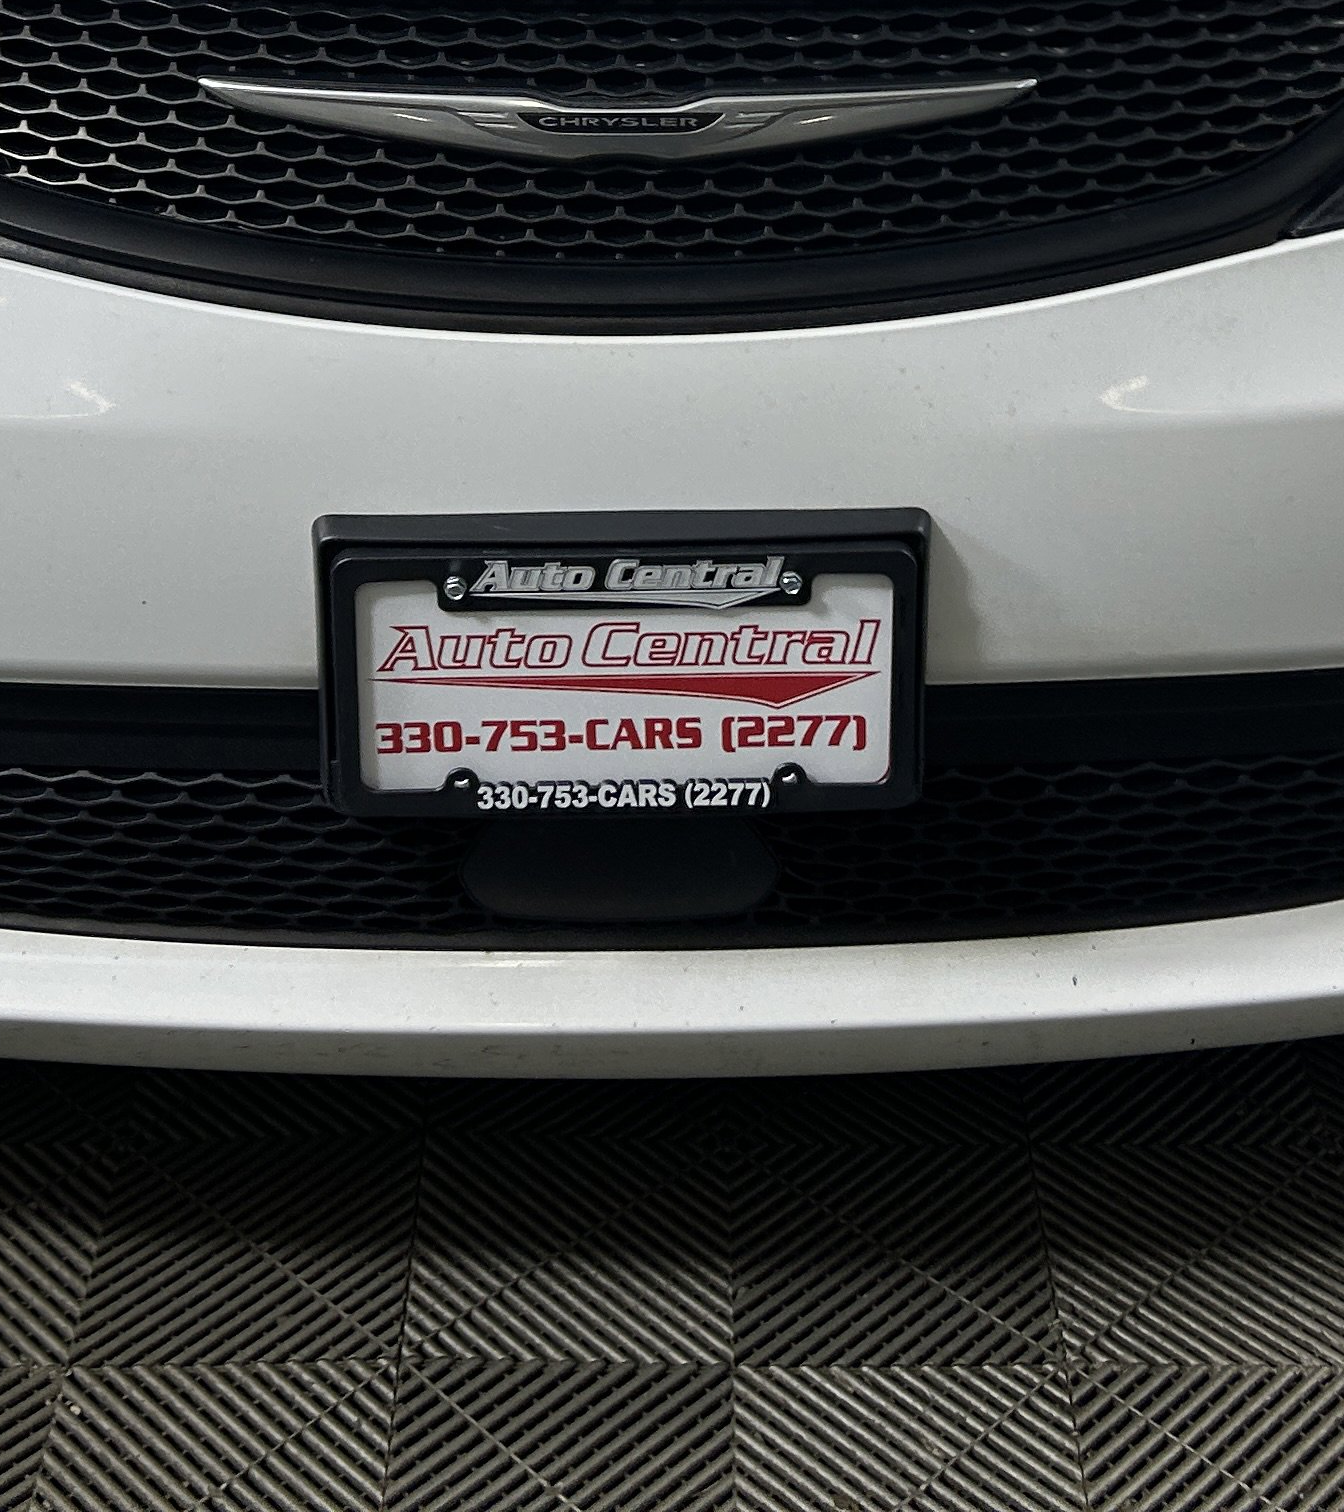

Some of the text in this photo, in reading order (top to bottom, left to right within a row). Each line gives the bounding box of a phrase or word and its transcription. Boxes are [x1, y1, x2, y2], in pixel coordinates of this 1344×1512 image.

[538, 116, 698, 128] CHRYSLER
[469, 555, 785, 592] Auto Central
[377, 618, 881, 672] Auto Central
[376, 714, 867, 755] 330-753-CARS (2277)
[477, 781, 771, 810] 330-753-CARS (2277)
